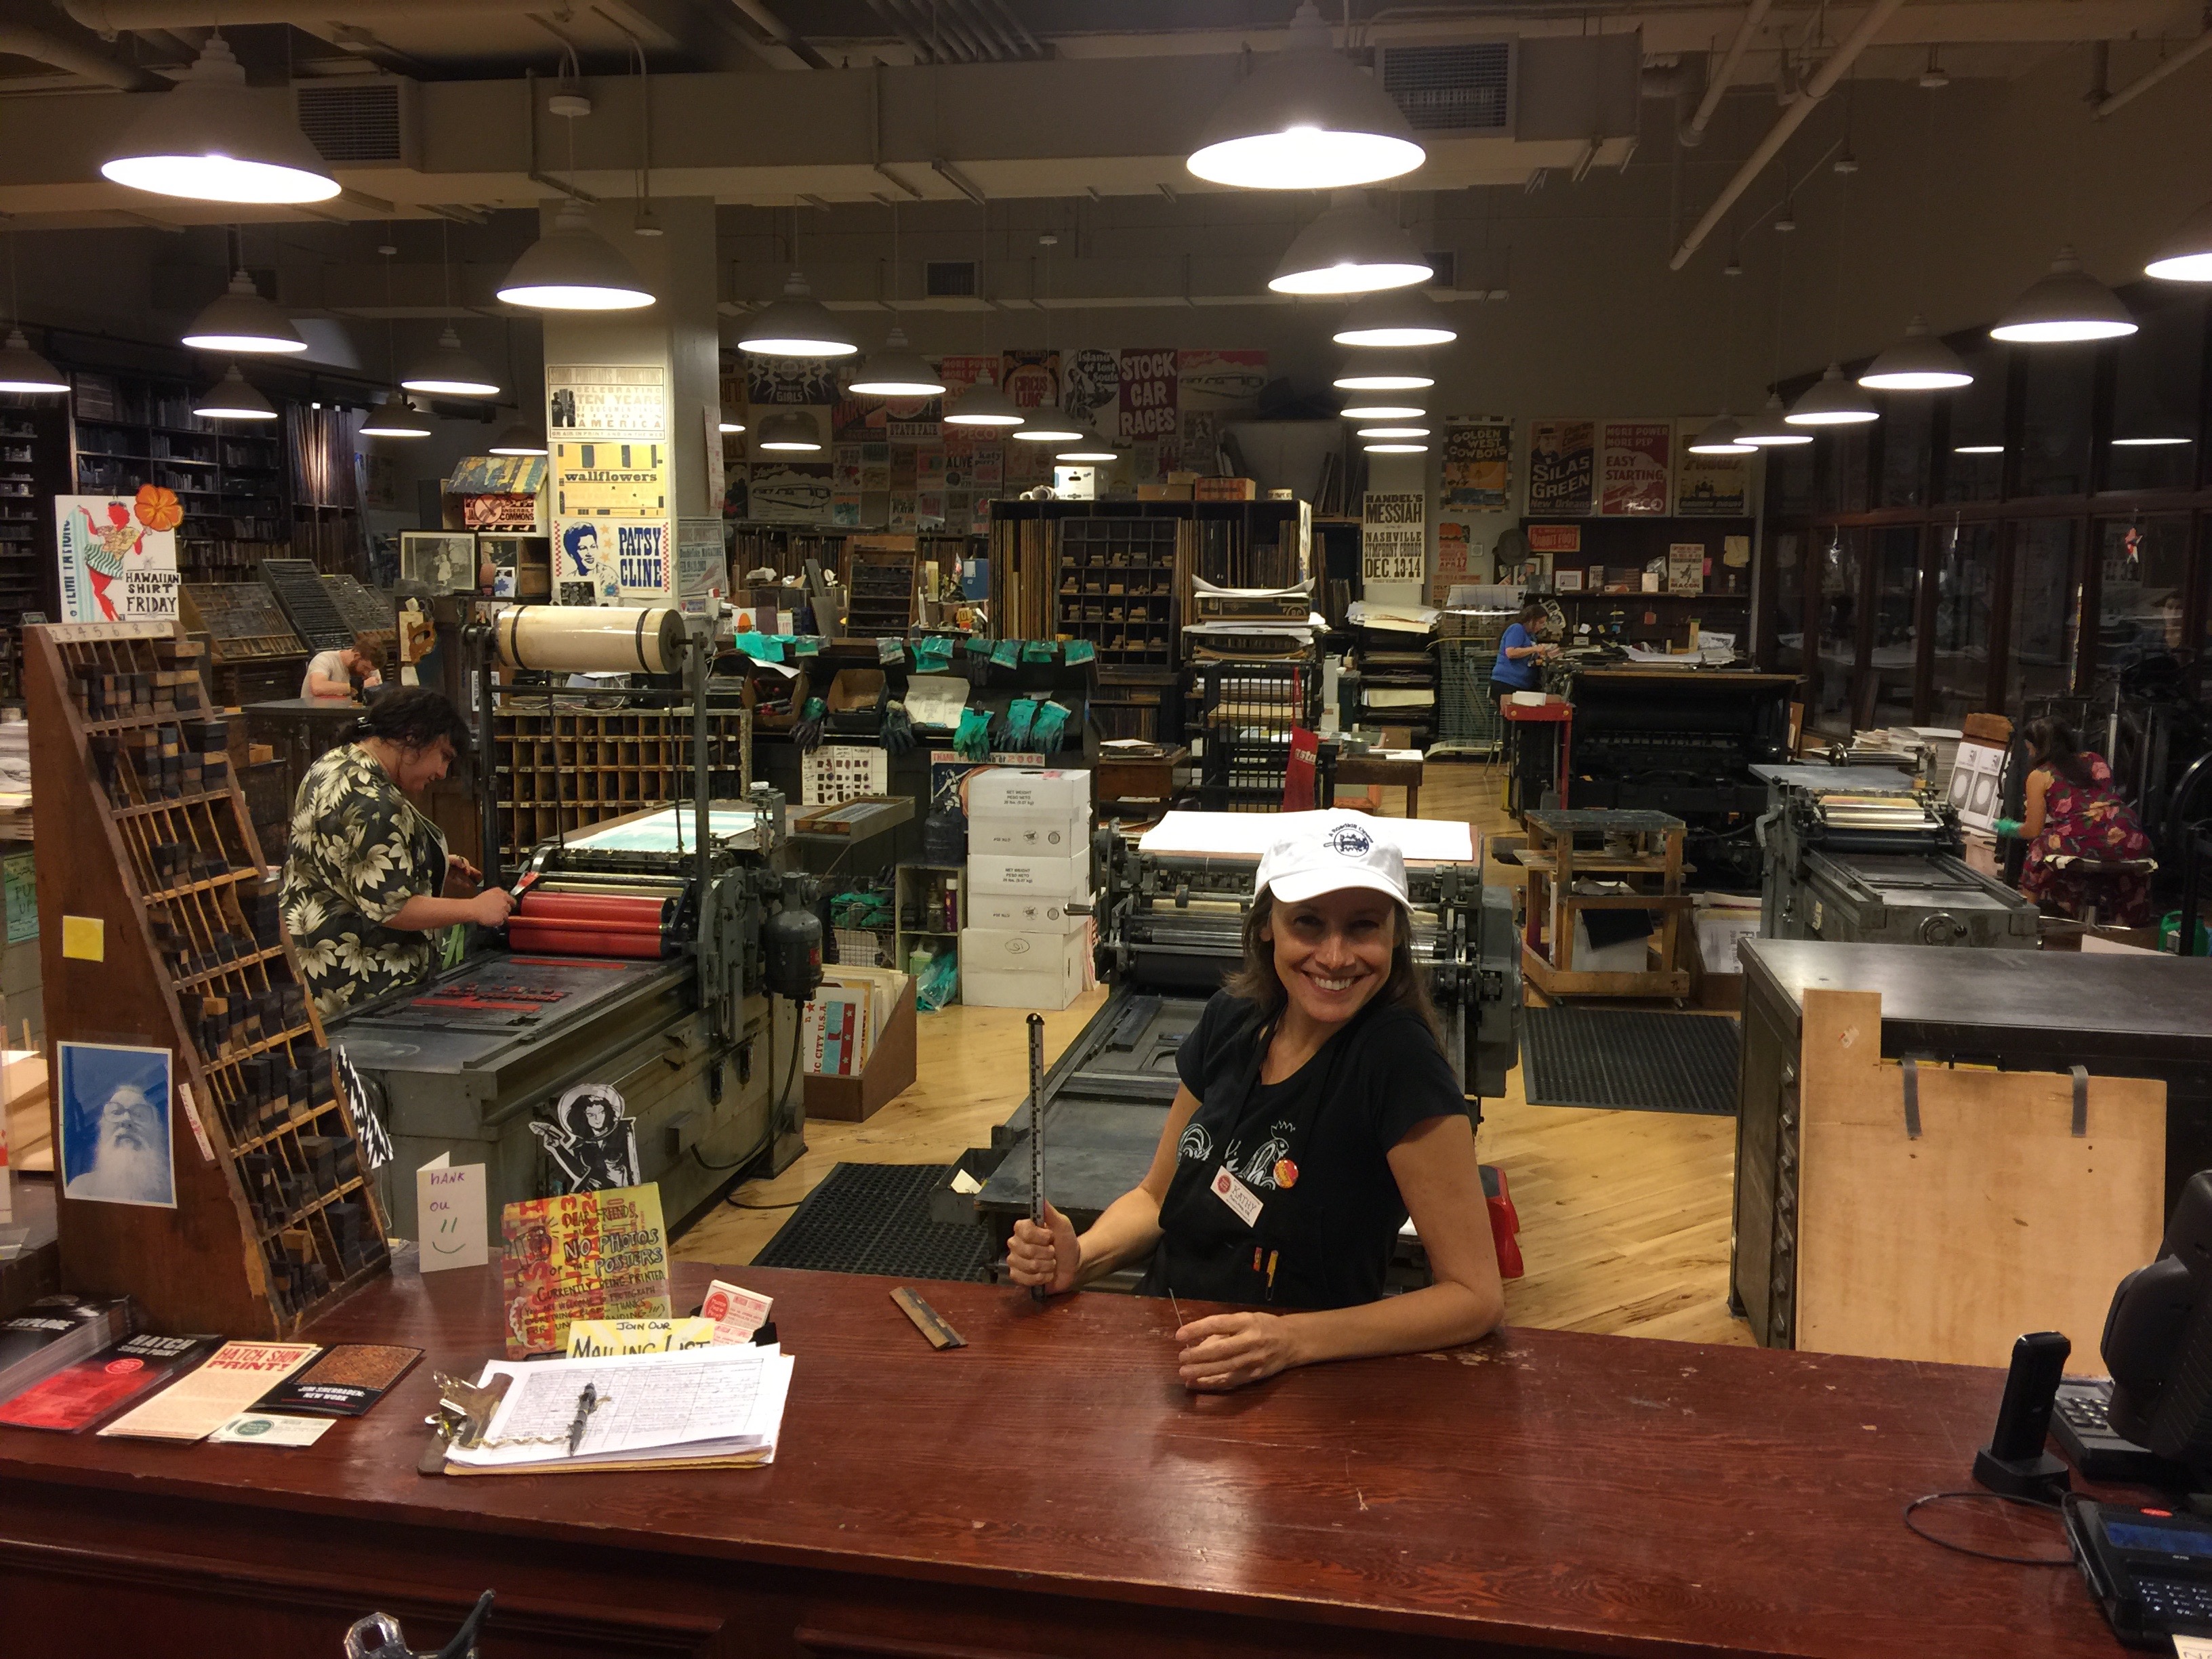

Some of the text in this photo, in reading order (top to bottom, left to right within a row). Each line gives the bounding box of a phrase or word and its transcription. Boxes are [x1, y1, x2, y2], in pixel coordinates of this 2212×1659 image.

[1078, 350, 1110, 362] Island
[1122, 352, 1177, 381] STOCK
[577, 394, 662, 405] TEN YEARS
[777, 392, 803, 402] GIRLS
[1130, 381, 1167, 407] CAR
[578, 419, 661, 428] AMERICA
[1120, 407, 1175, 435] RACES
[890, 424, 939, 435] STATE FAIR
[958, 428, 996, 440] PECO
[1607, 427, 1668, 435] MORE POWER
[1452, 430, 1501, 443] GOLDEN
[1607, 438, 1654, 447] MORE PEP
[1468, 438, 1502, 448] WEST
[1449, 446, 1507, 458] COWBOYS
[946, 455, 972, 468] ALIVE
[1606, 456, 1636, 466] EASY
[1532, 456, 1590, 482] SILAS
[1605, 470, 1663, 480] STARTING
[565, 471, 657, 481] wallflowers
[1532, 472, 1590, 498] GREEN
[1366, 494, 1422, 503] HANDEL'S
[499, 513, 534, 521] COMMONS
[1366, 504, 1422, 524] MESSIAH
[618, 527, 661, 556] PATSY
[1366, 532, 1422, 542] NASHVILLE
[1365, 542, 1397, 558] SYMPHONY
[1365, 558, 1421, 578] DEC. 13-14
[1456, 557, 1467, 567] 17
[125, 573, 180, 584] HAWAIIAN
[620, 558, 662, 588] CLINE
[128, 584, 173, 594] SHIRT
[126, 596, 176, 613] FRIDAY
[63, 628, 73, 639] 3
[77, 626, 86, 638] 4
[93, 626, 102, 637] 5
[112, 626, 119, 637] 6
[933, 753, 955, 761] THANK
[1331, 823, 1357, 833] Roadkill
[818, 1002, 827, 1031] U.S.A.
[815, 1034, 824, 1059] CITY
[563, 1228, 659, 1262] NO PHOTOS
[550, 1247, 663, 1277] OF THE POSTERS
[537, 1282, 592, 1302] CURRENTLY
[600, 1275, 626, 1290] BEING
[610, 1298, 646, 1313] THANKS
[616, 1322, 672, 1330] JOIN OUR
[127, 1334, 198, 1350] HATCH
[215, 1347, 305, 1363] HATCH SHOW
[323, 1393, 349, 1401] WORK
